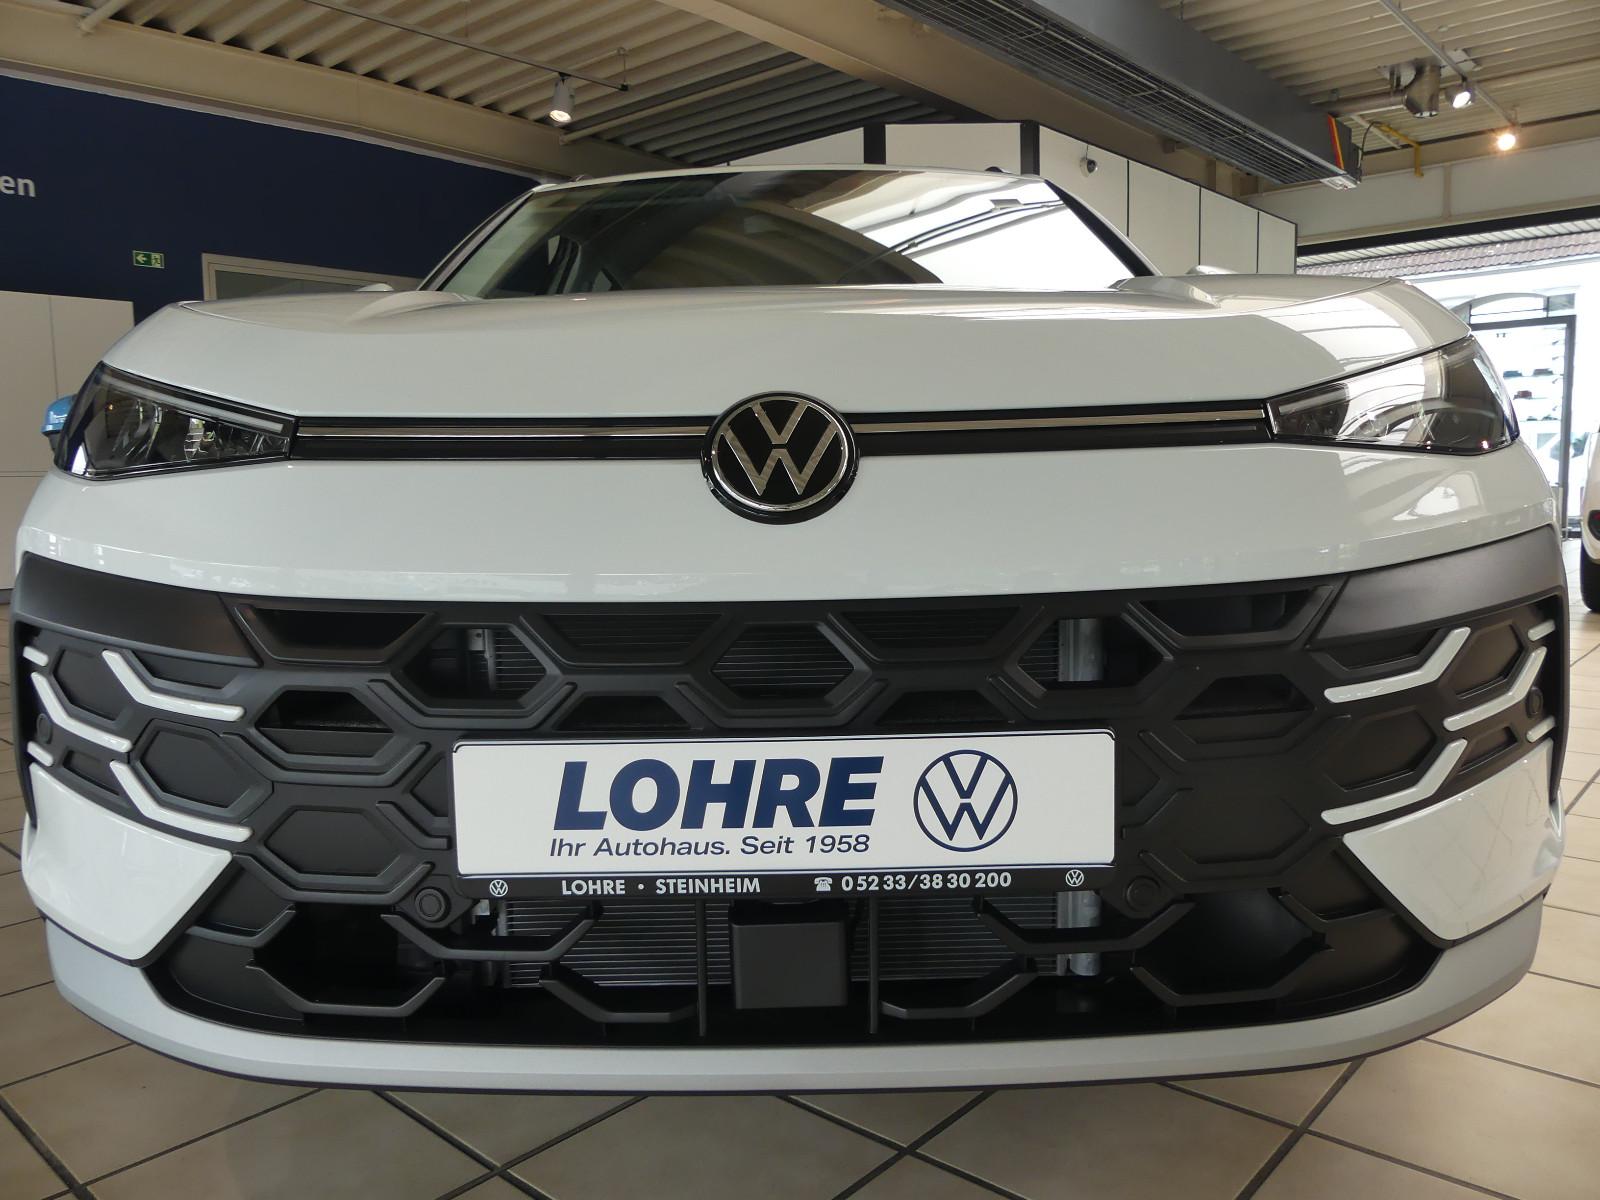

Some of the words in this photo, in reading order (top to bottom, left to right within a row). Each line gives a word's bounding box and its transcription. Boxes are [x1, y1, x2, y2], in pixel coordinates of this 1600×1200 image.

[712, 397, 848, 512] VW
[553, 756, 885, 832] LOHRE
[913, 750, 1018, 852] VW
[550, 838, 587, 857] Ihr
[593, 837, 730, 857] Autohaus.
[740, 835, 795, 855] Seit
[805, 833, 870, 854] 1958
[561, 879, 626, 896] LOHRE
[655, 877, 762, 895] STEINHEIM
